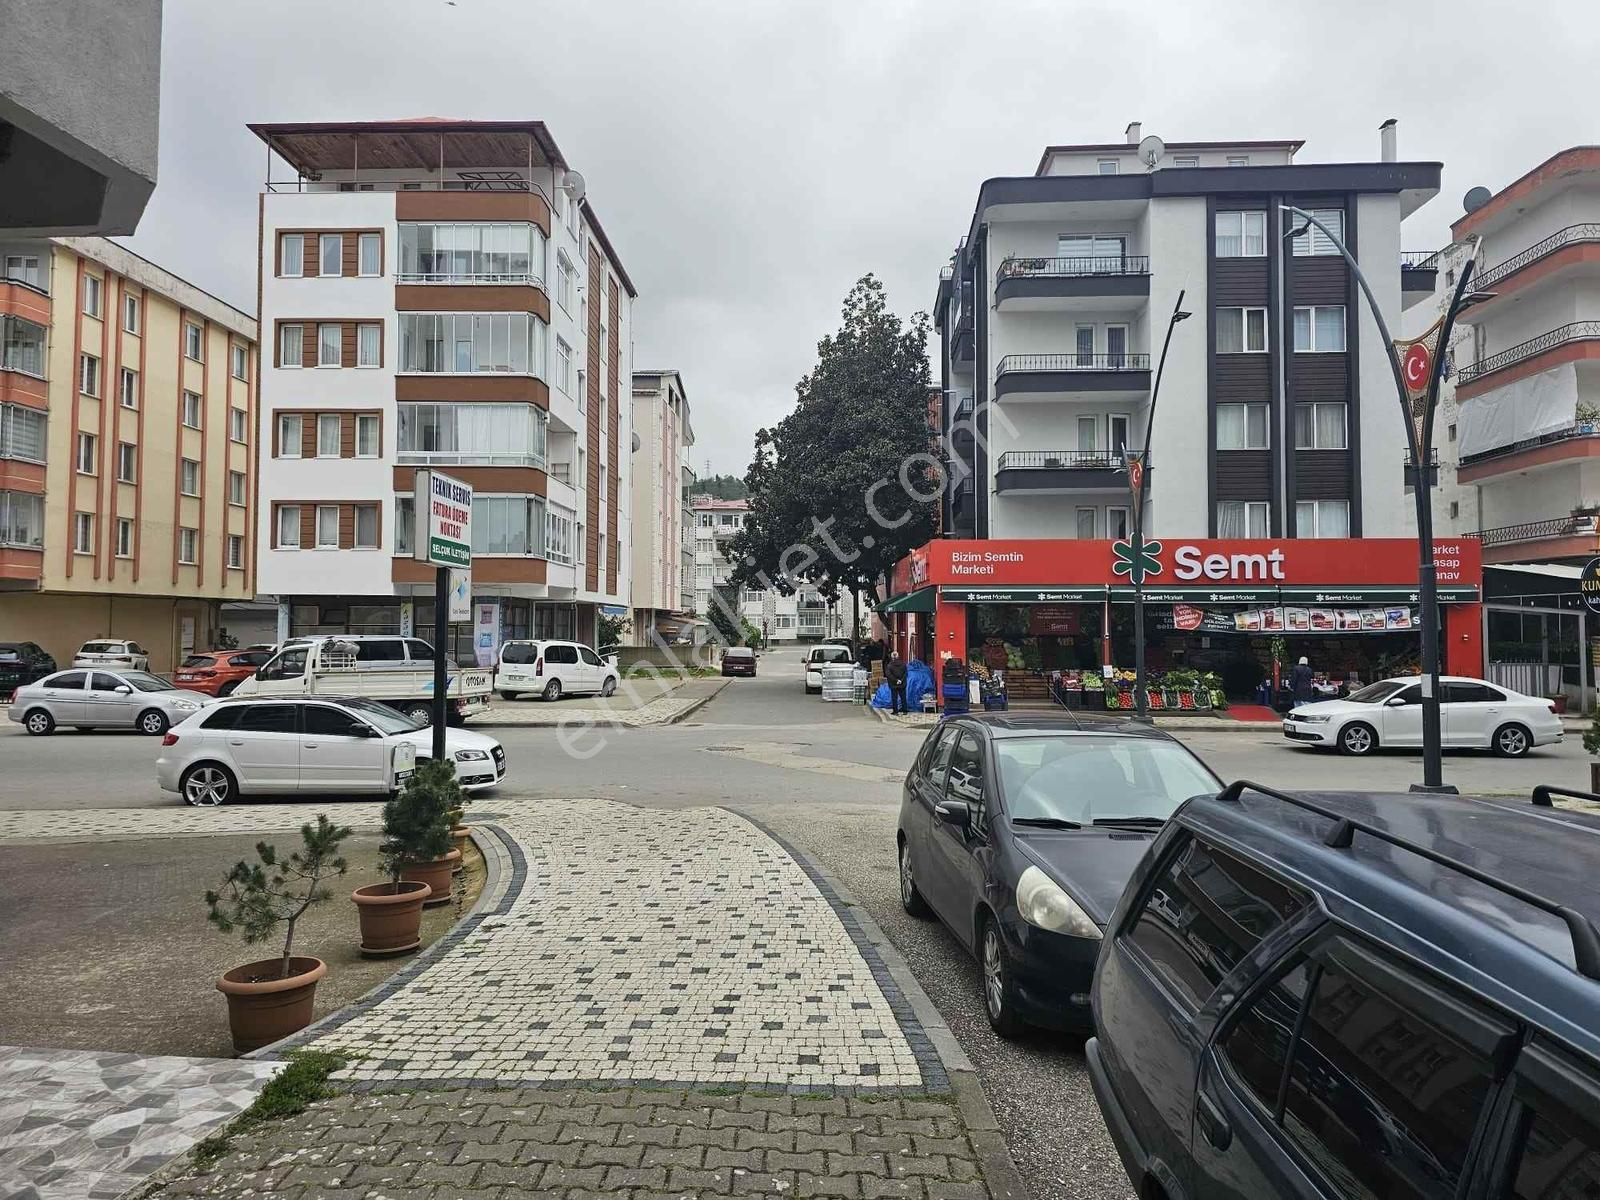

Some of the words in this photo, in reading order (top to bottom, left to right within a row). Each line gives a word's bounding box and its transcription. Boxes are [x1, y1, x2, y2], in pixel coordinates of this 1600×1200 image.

[433, 500, 451, 519] FATURA
[432, 543, 451, 557] SELÇUK
[1432, 545, 1460, 555] arket
[952, 551, 982, 562] Bizim
[984, 551, 1024, 562] Semtin
[1174, 545, 1286, 580] Semt
[1433, 559, 1460, 569] asap
[951, 564, 994, 575] Marketi
[1436, 572, 1460, 580] anav
